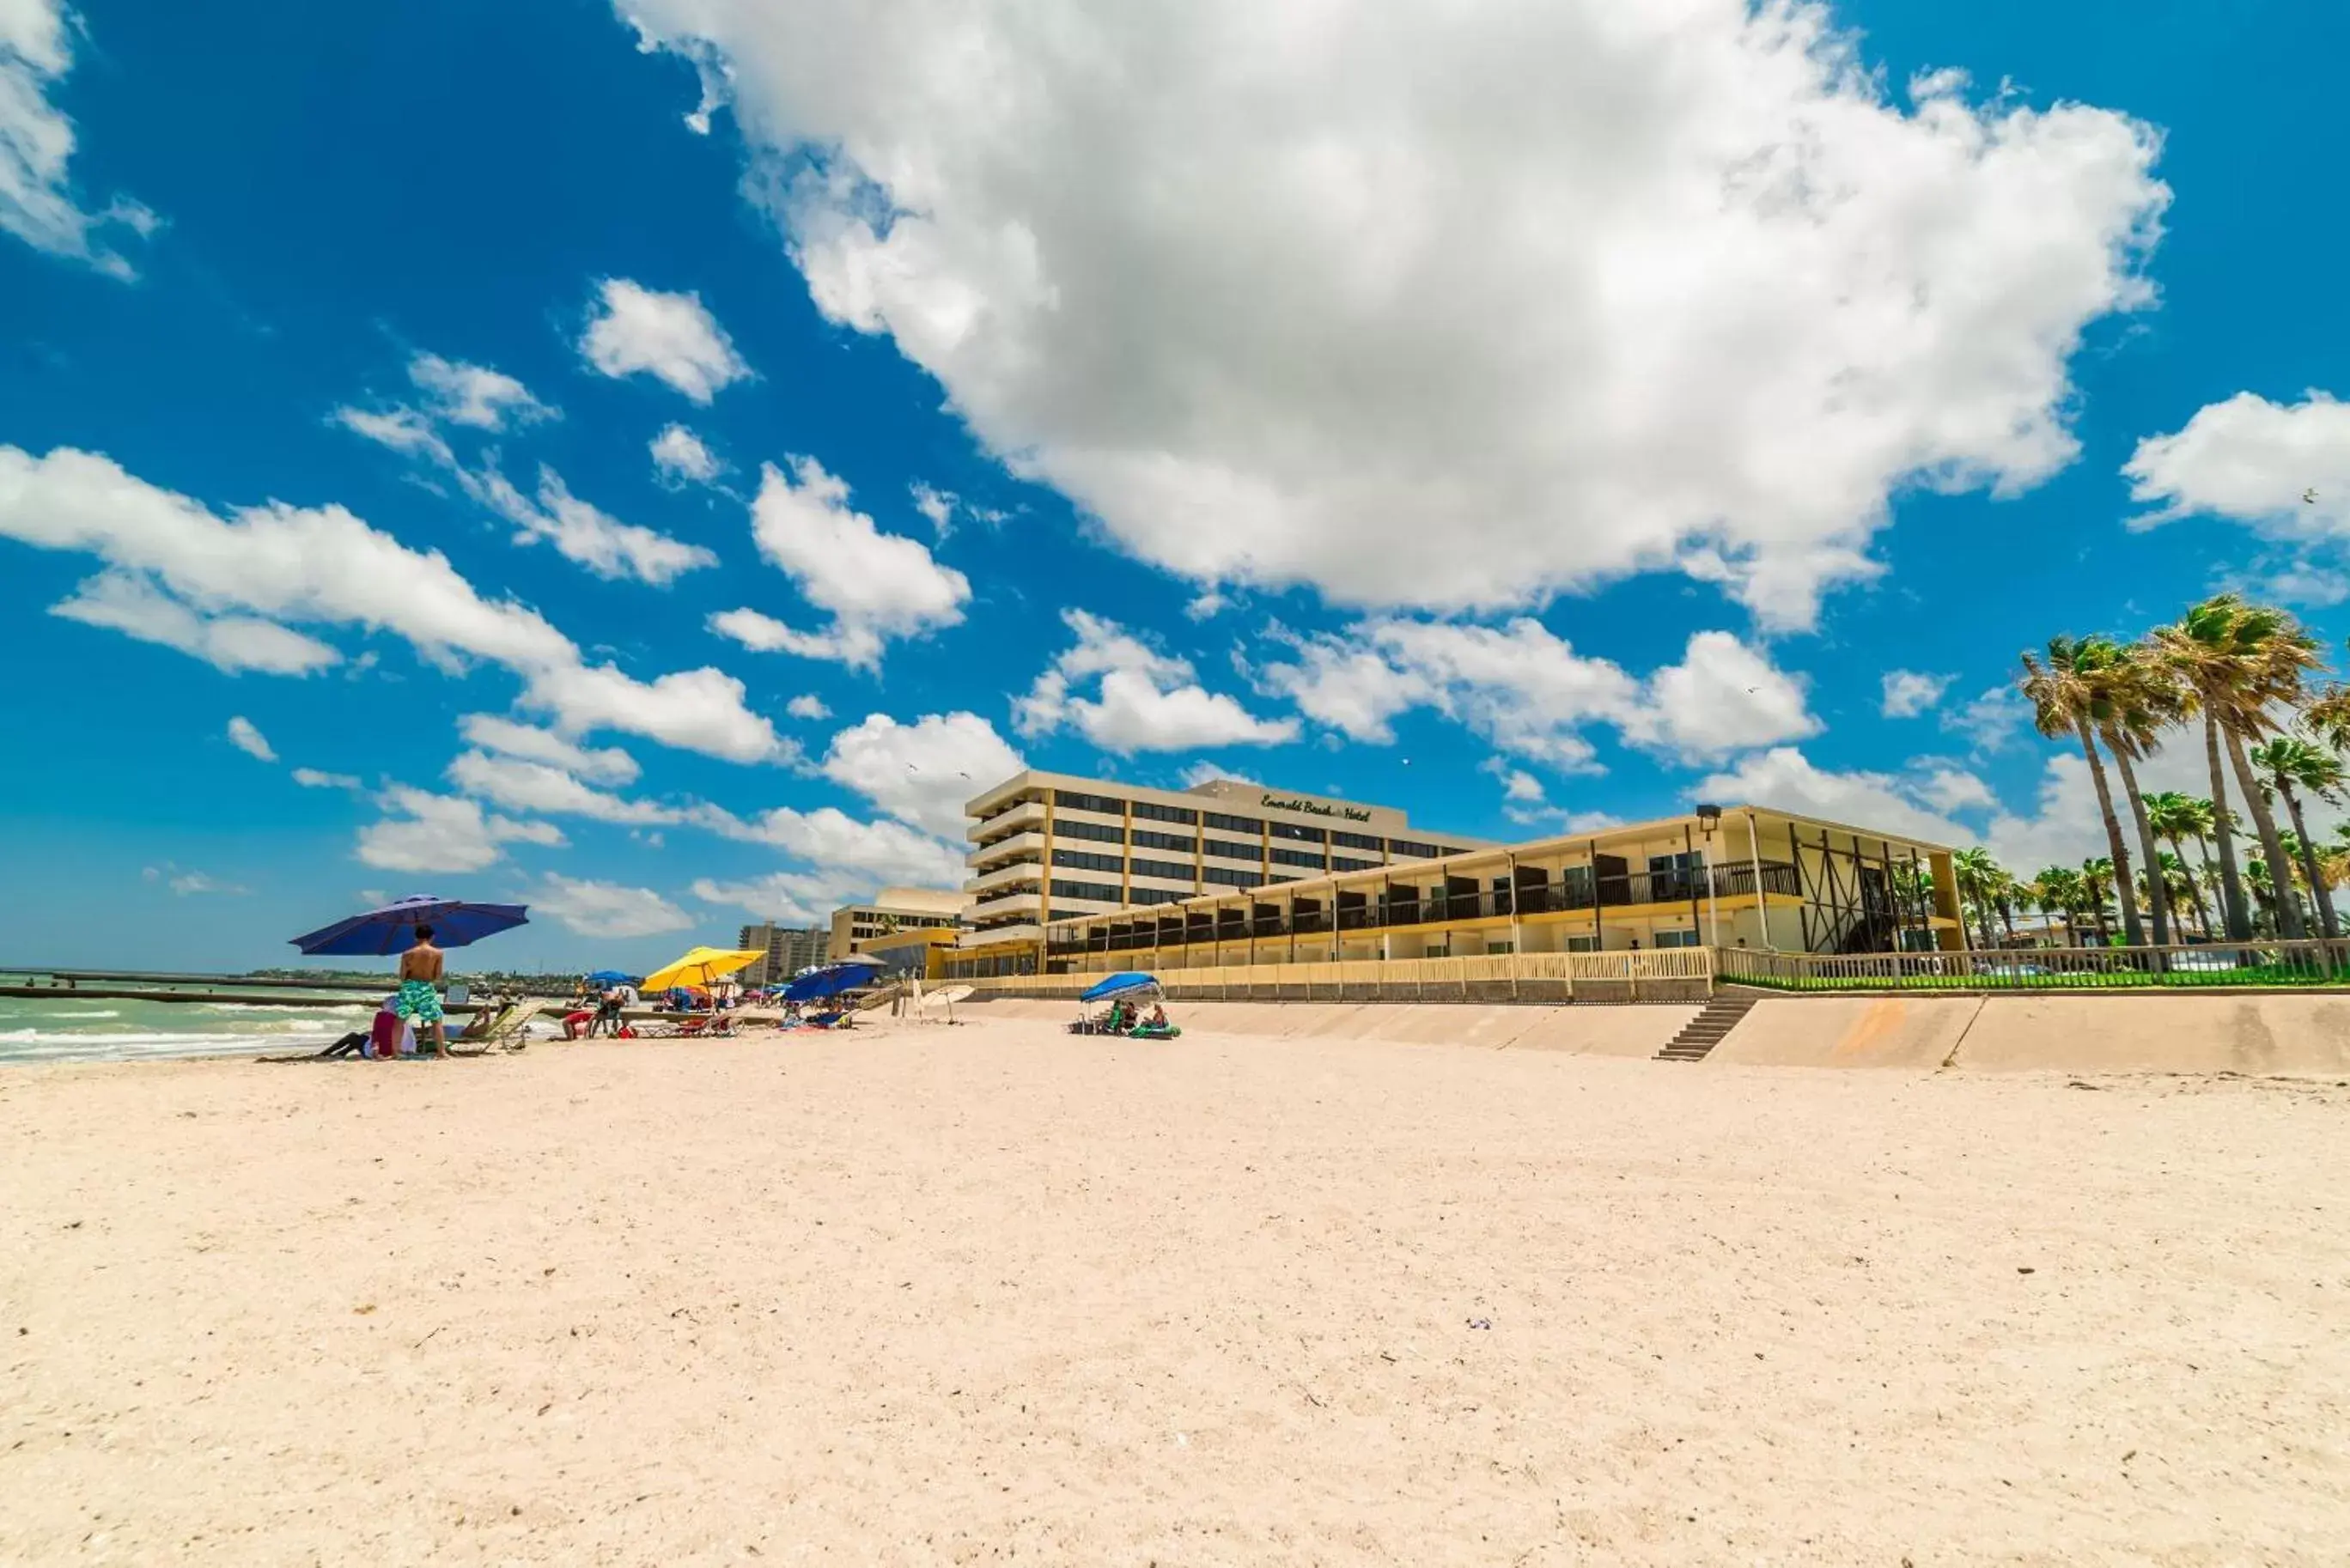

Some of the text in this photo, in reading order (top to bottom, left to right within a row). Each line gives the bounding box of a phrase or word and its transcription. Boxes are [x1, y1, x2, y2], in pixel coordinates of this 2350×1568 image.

[1261, 794, 1372, 823] Emerald Beach Hotel
